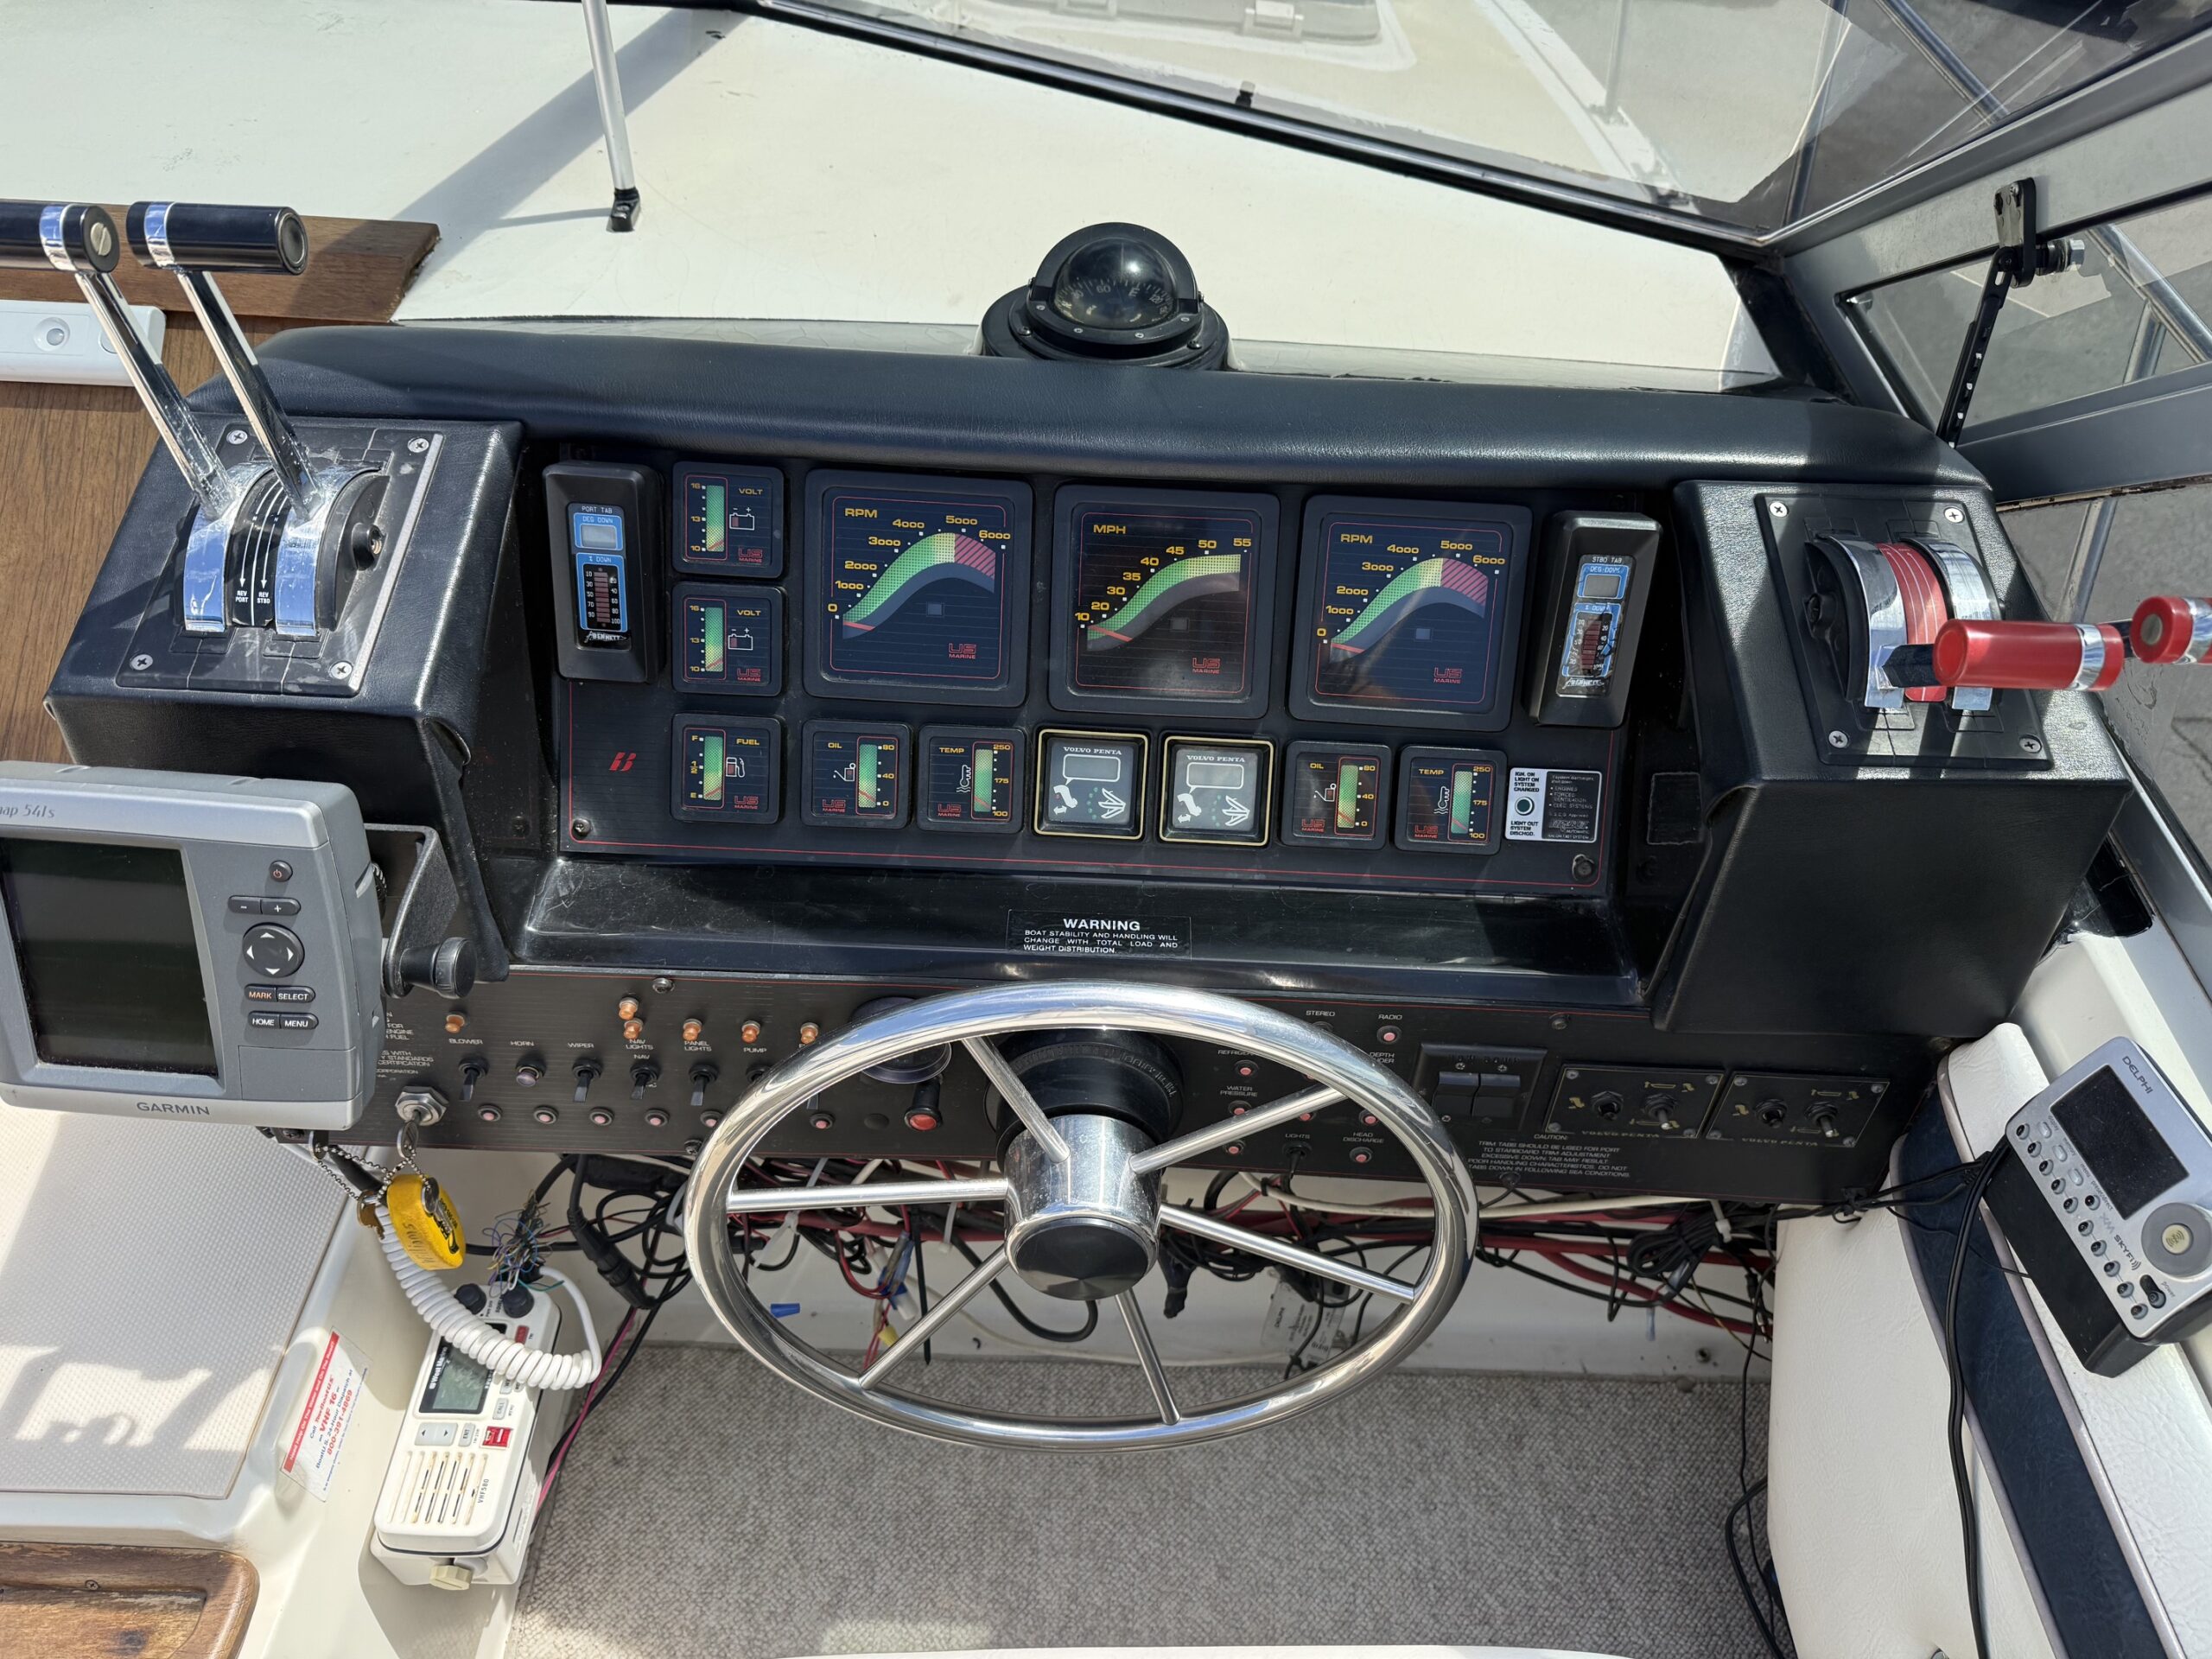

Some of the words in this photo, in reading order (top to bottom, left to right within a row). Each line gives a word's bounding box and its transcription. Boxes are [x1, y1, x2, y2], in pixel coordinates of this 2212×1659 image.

[1128, 287, 1141, 297] E
[845, 508, 877, 518] RPM
[893, 518, 925, 529] 4000
[945, 515, 978, 525] 5000
[1094, 524, 1126, 535] MPH
[979, 530, 1011, 540] 6000
[1341, 534, 1373, 543] RPM
[868, 537, 901, 546] 3000
[1198, 540, 1217, 549] 50
[1233, 538, 1251, 547] 55
[1440, 540, 1472, 550] 5000
[1166, 546, 1184, 556] 45
[1387, 543, 1420, 554] 4000
[1141, 557, 1159, 566] 40
[1472, 555, 1505, 565] 6000
[845, 561, 877, 570] 2000
[1362, 562, 1394, 572] 3000
[1122, 572, 1141, 581] 35
[835, 581, 864, 590] 1000
[1107, 586, 1125, 595] 30
[1337, 586, 1369, 595] 2000
[828, 603, 838, 613] 0
[1091, 601, 1109, 611] 20
[1325, 606, 1354, 615] 1000
[1075, 612, 1090, 621] 10
[1317, 628, 1327, 637] 0
[948, 643, 977, 654] US
[1192, 658, 1221, 669] US
[1433, 667, 1462, 678] US
[22, 804, 54, 817] 541s
[1063, 918, 1141, 931] WARNING
[2122, 1056, 2153, 1094] DELPHI
[137, 1102, 210, 1116] GARMIN
[2100, 1212, 2114, 1234] XM
[2161, 1281, 2176, 1297] power
[431, 1367, 442, 1382] West
[327, 1408, 340, 1437] 24-Hour
[336, 1377, 351, 1408] Dispatch
[496, 1401, 505, 1414] CALL
[319, 1408, 332, 1433] VHF
[328, 1392, 338, 1405] 16
[326, 1389, 353, 1456] 800-391-4869
[308, 1426, 317, 1439] Call
[461, 1428, 471, 1440] ENT
[477, 1478, 490, 1503] VHF580
